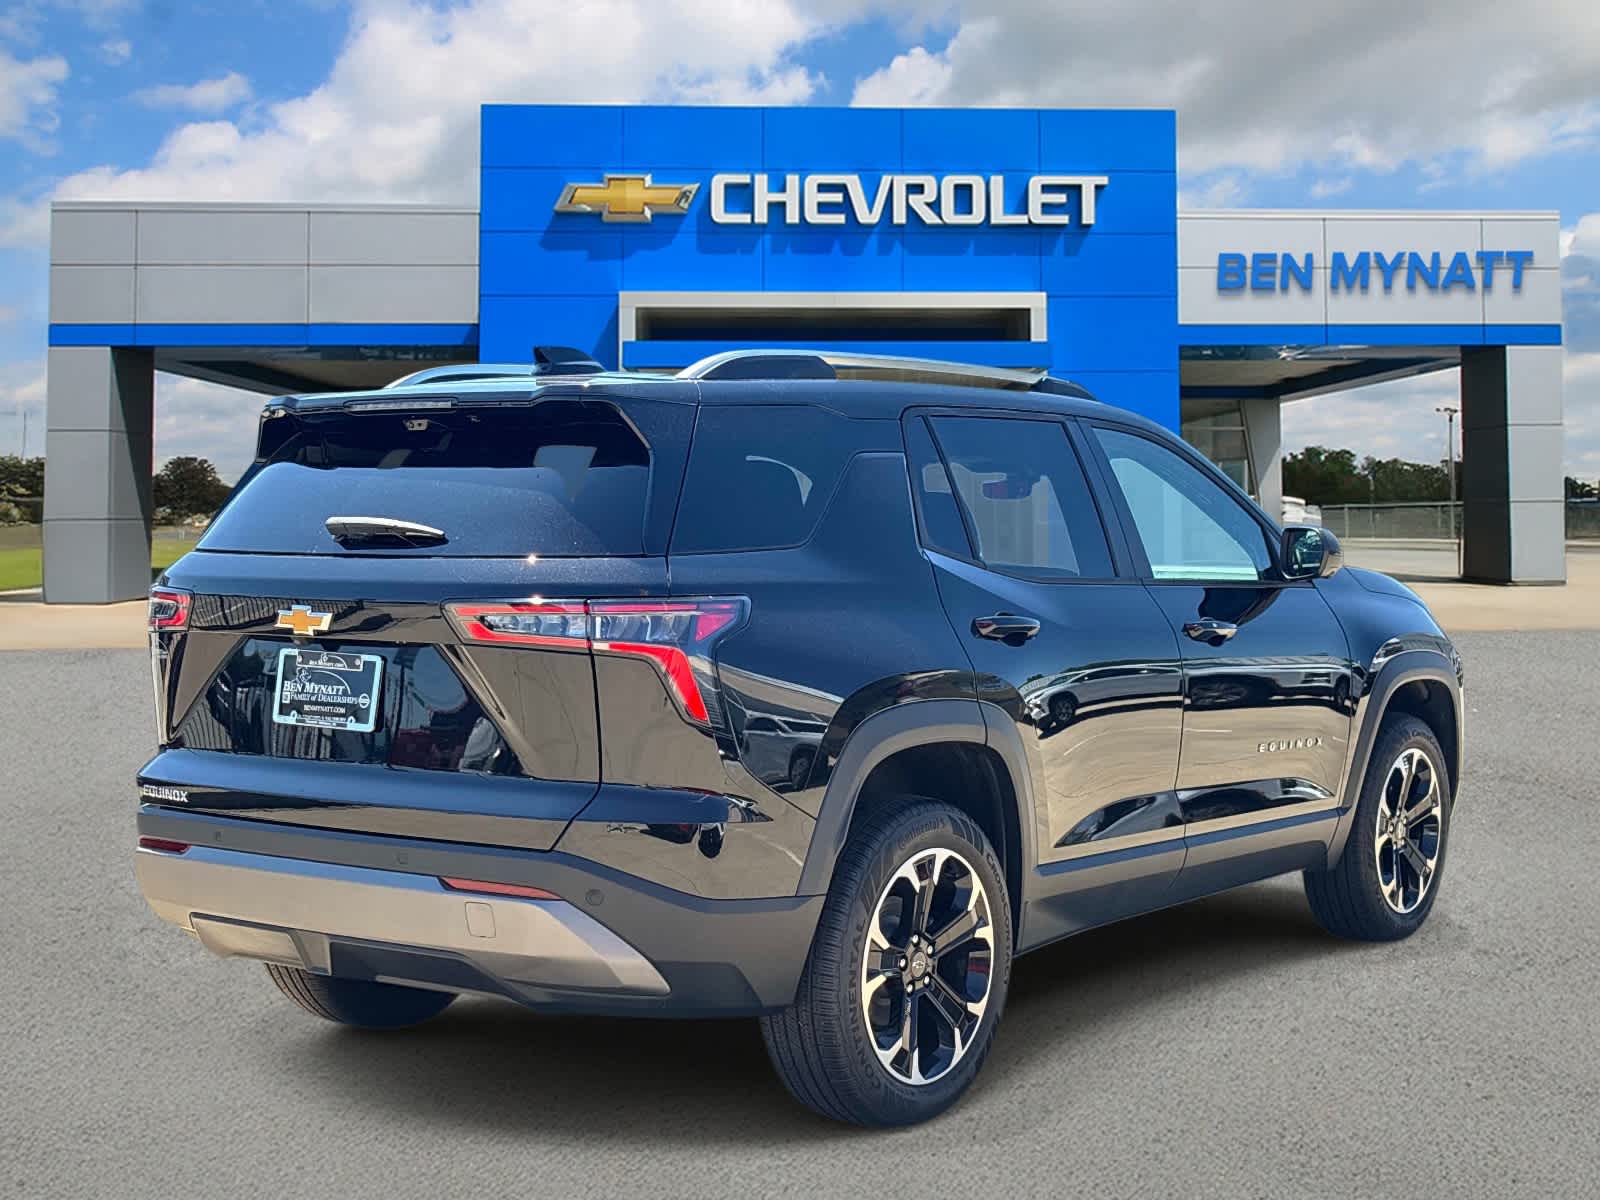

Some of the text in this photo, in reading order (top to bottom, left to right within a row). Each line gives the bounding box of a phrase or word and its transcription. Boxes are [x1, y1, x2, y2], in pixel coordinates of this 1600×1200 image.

[710, 173, 1109, 227] CHEVROLET
[1217, 250, 1534, 294] BEN MYNATT
[283, 680, 346, 695] BEN MYNATT
[318, 693, 358, 705] DEALERSHIPS
[1257, 736, 1323, 753] EQUINOX
[143, 784, 189, 803] EQUINOX
